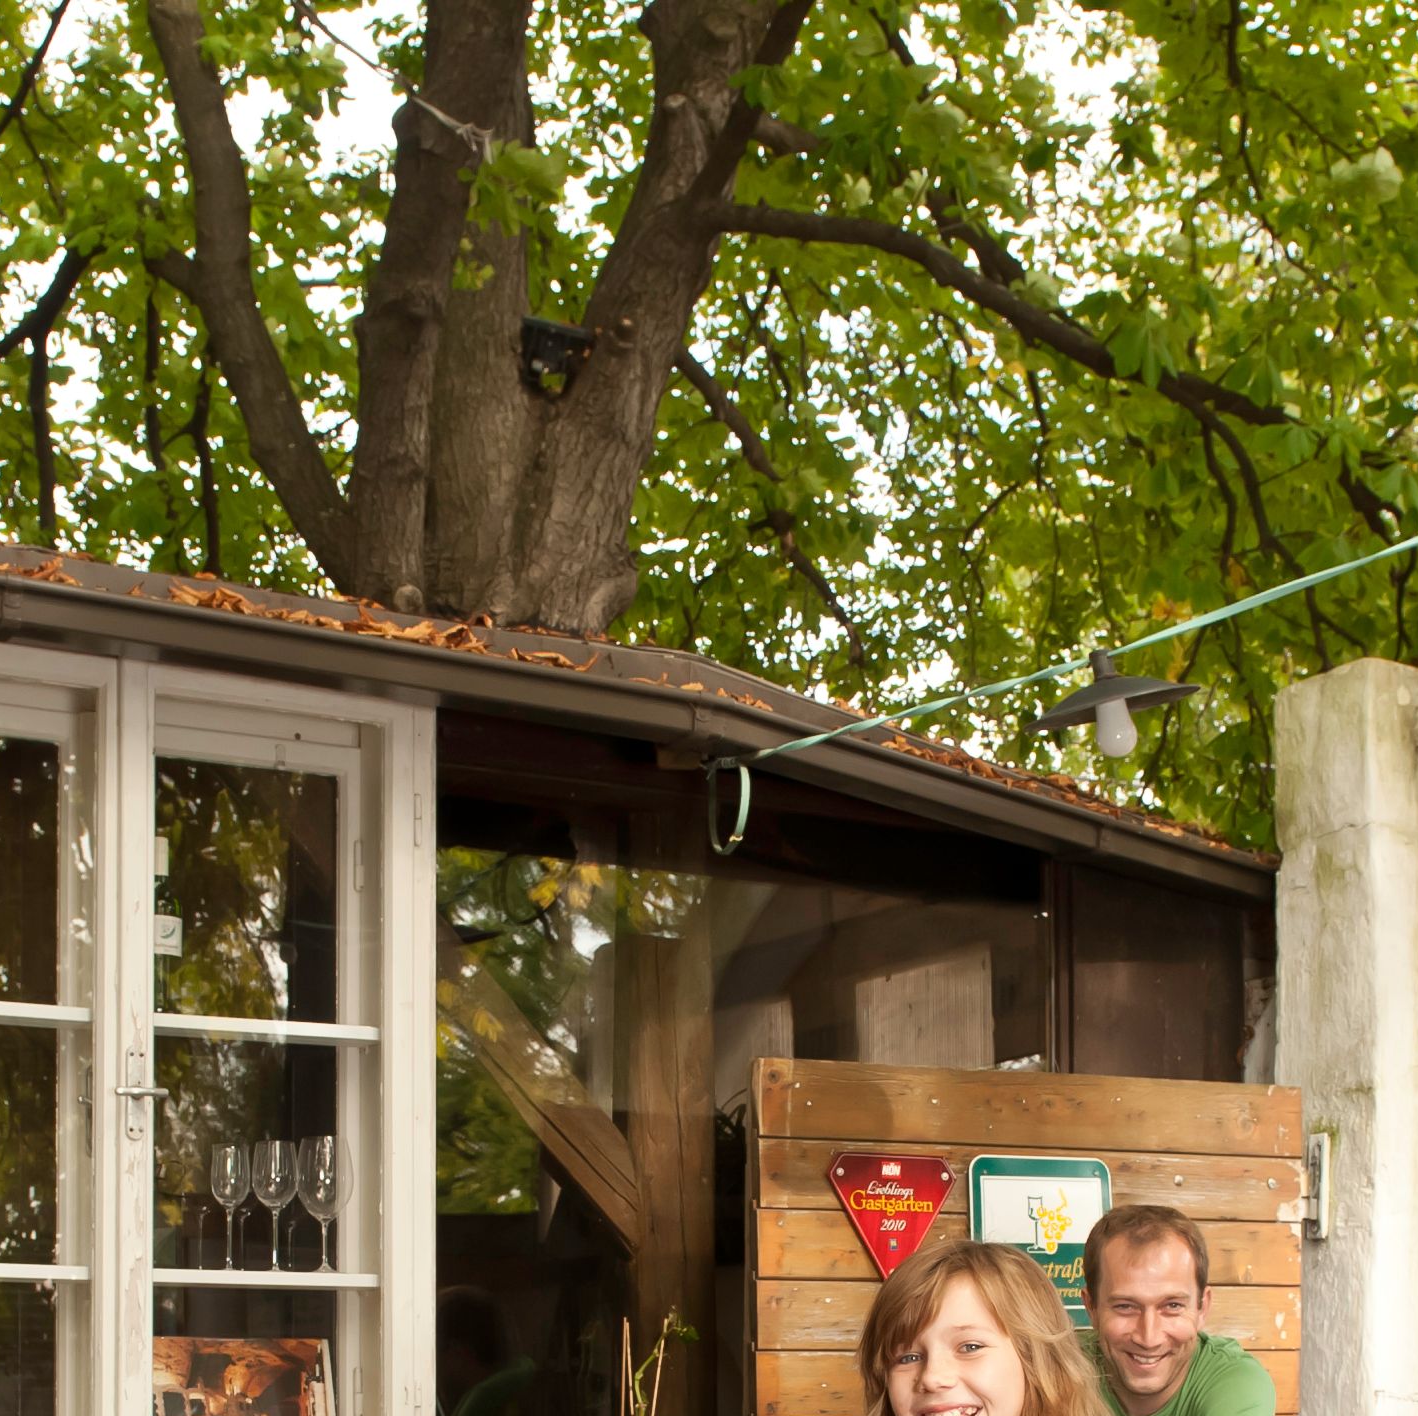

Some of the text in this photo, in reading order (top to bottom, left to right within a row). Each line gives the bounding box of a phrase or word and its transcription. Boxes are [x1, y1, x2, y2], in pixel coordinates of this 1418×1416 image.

[882, 1163, 901, 1176] NÖN
[867, 1181, 914, 1199] Lieblings
[850, 1190, 933, 1216] Gastgarten
[881, 1219, 906, 1231] 2010
